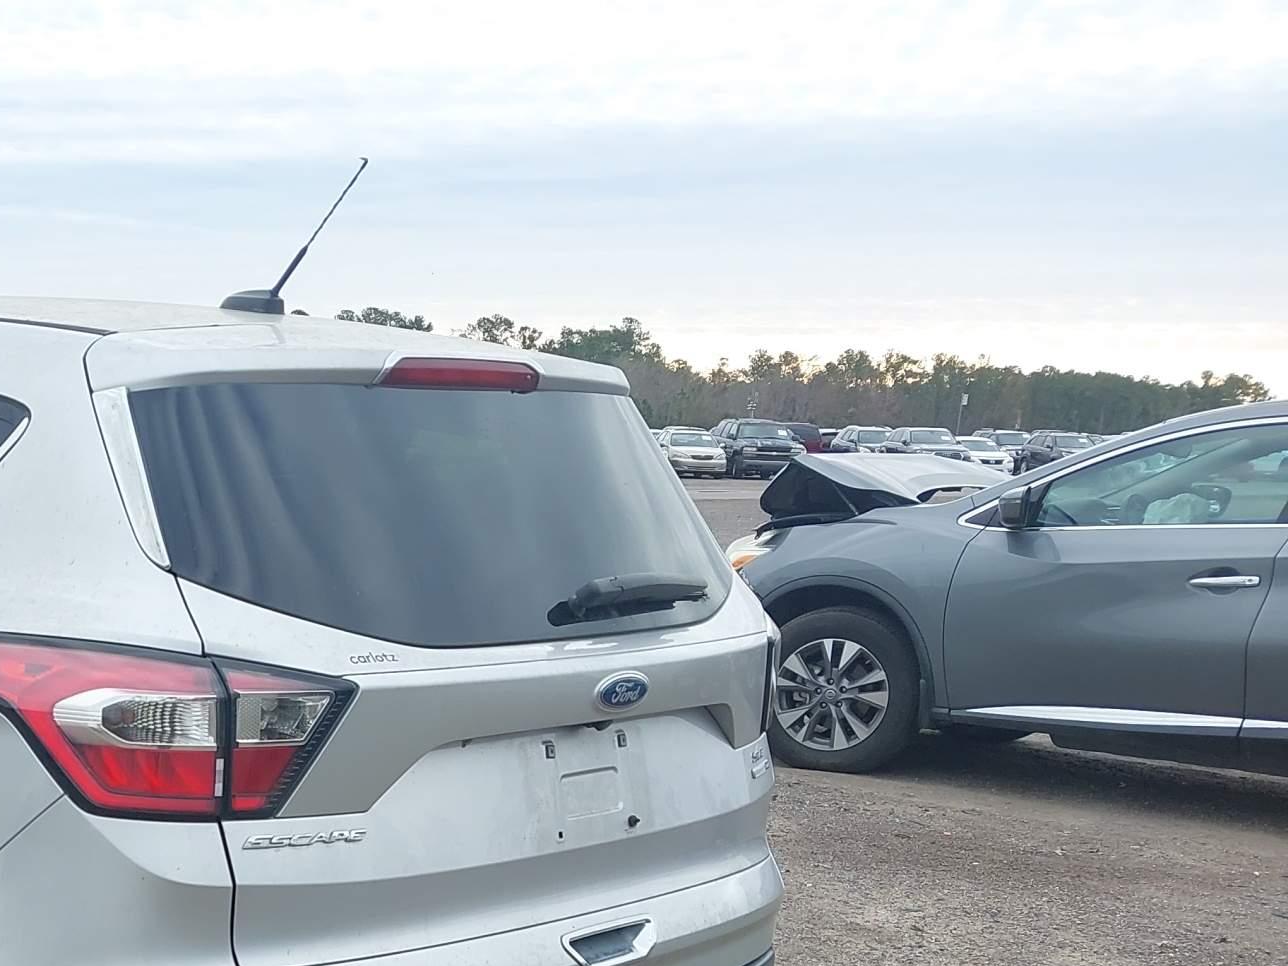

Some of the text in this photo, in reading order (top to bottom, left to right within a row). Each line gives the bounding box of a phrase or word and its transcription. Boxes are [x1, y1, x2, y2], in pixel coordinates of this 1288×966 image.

[349, 651, 399, 664] carlotz
[611, 682, 641, 703] Ford
[241, 828, 367, 850] ESCAPE
